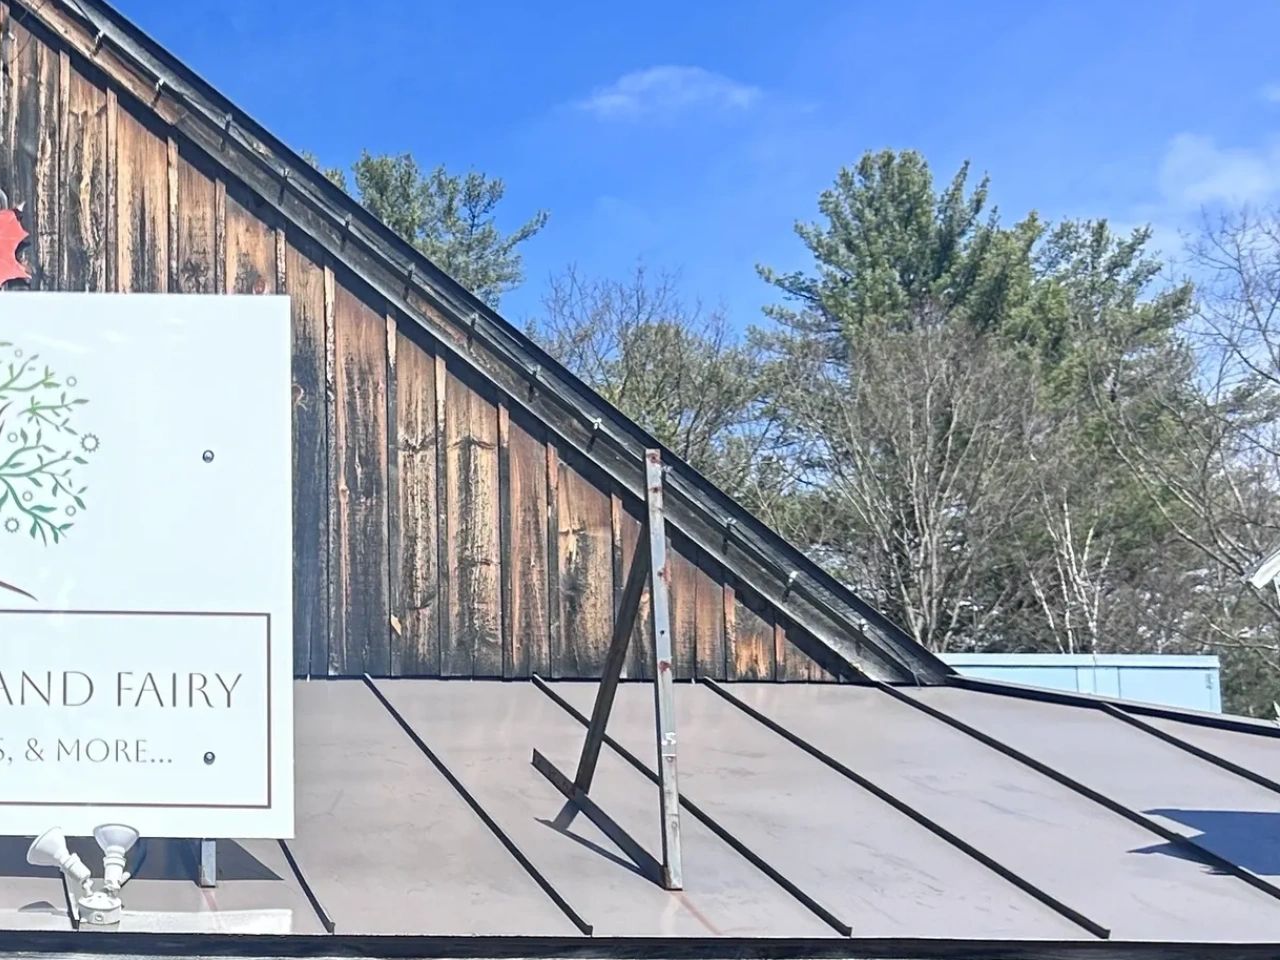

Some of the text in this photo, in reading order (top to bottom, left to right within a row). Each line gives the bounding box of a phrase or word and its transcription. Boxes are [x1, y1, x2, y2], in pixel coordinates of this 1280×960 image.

[116, 671, 243, 709] FAIRY
[25, 738, 45, 763] &
[56, 738, 173, 765] MORE...
